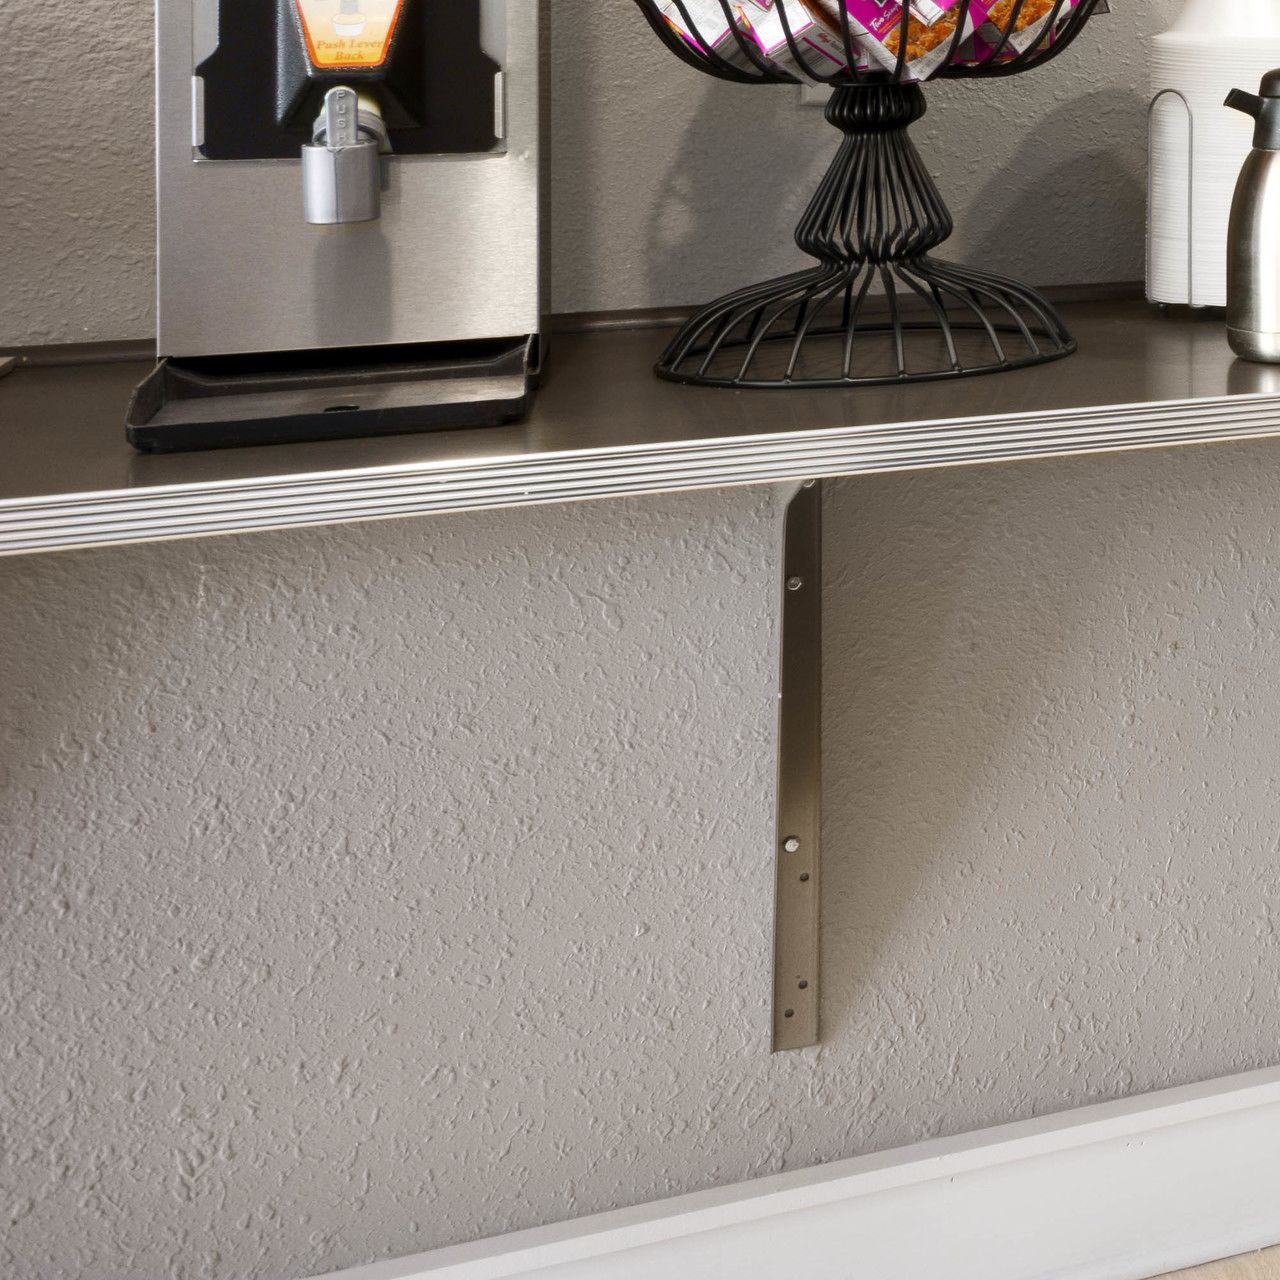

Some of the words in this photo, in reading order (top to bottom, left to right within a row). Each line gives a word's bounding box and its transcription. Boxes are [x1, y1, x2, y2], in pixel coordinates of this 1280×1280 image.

[317, 40, 346, 50] Push
[349, 39, 384, 49] Lever
[334, 52, 364, 61] Back
